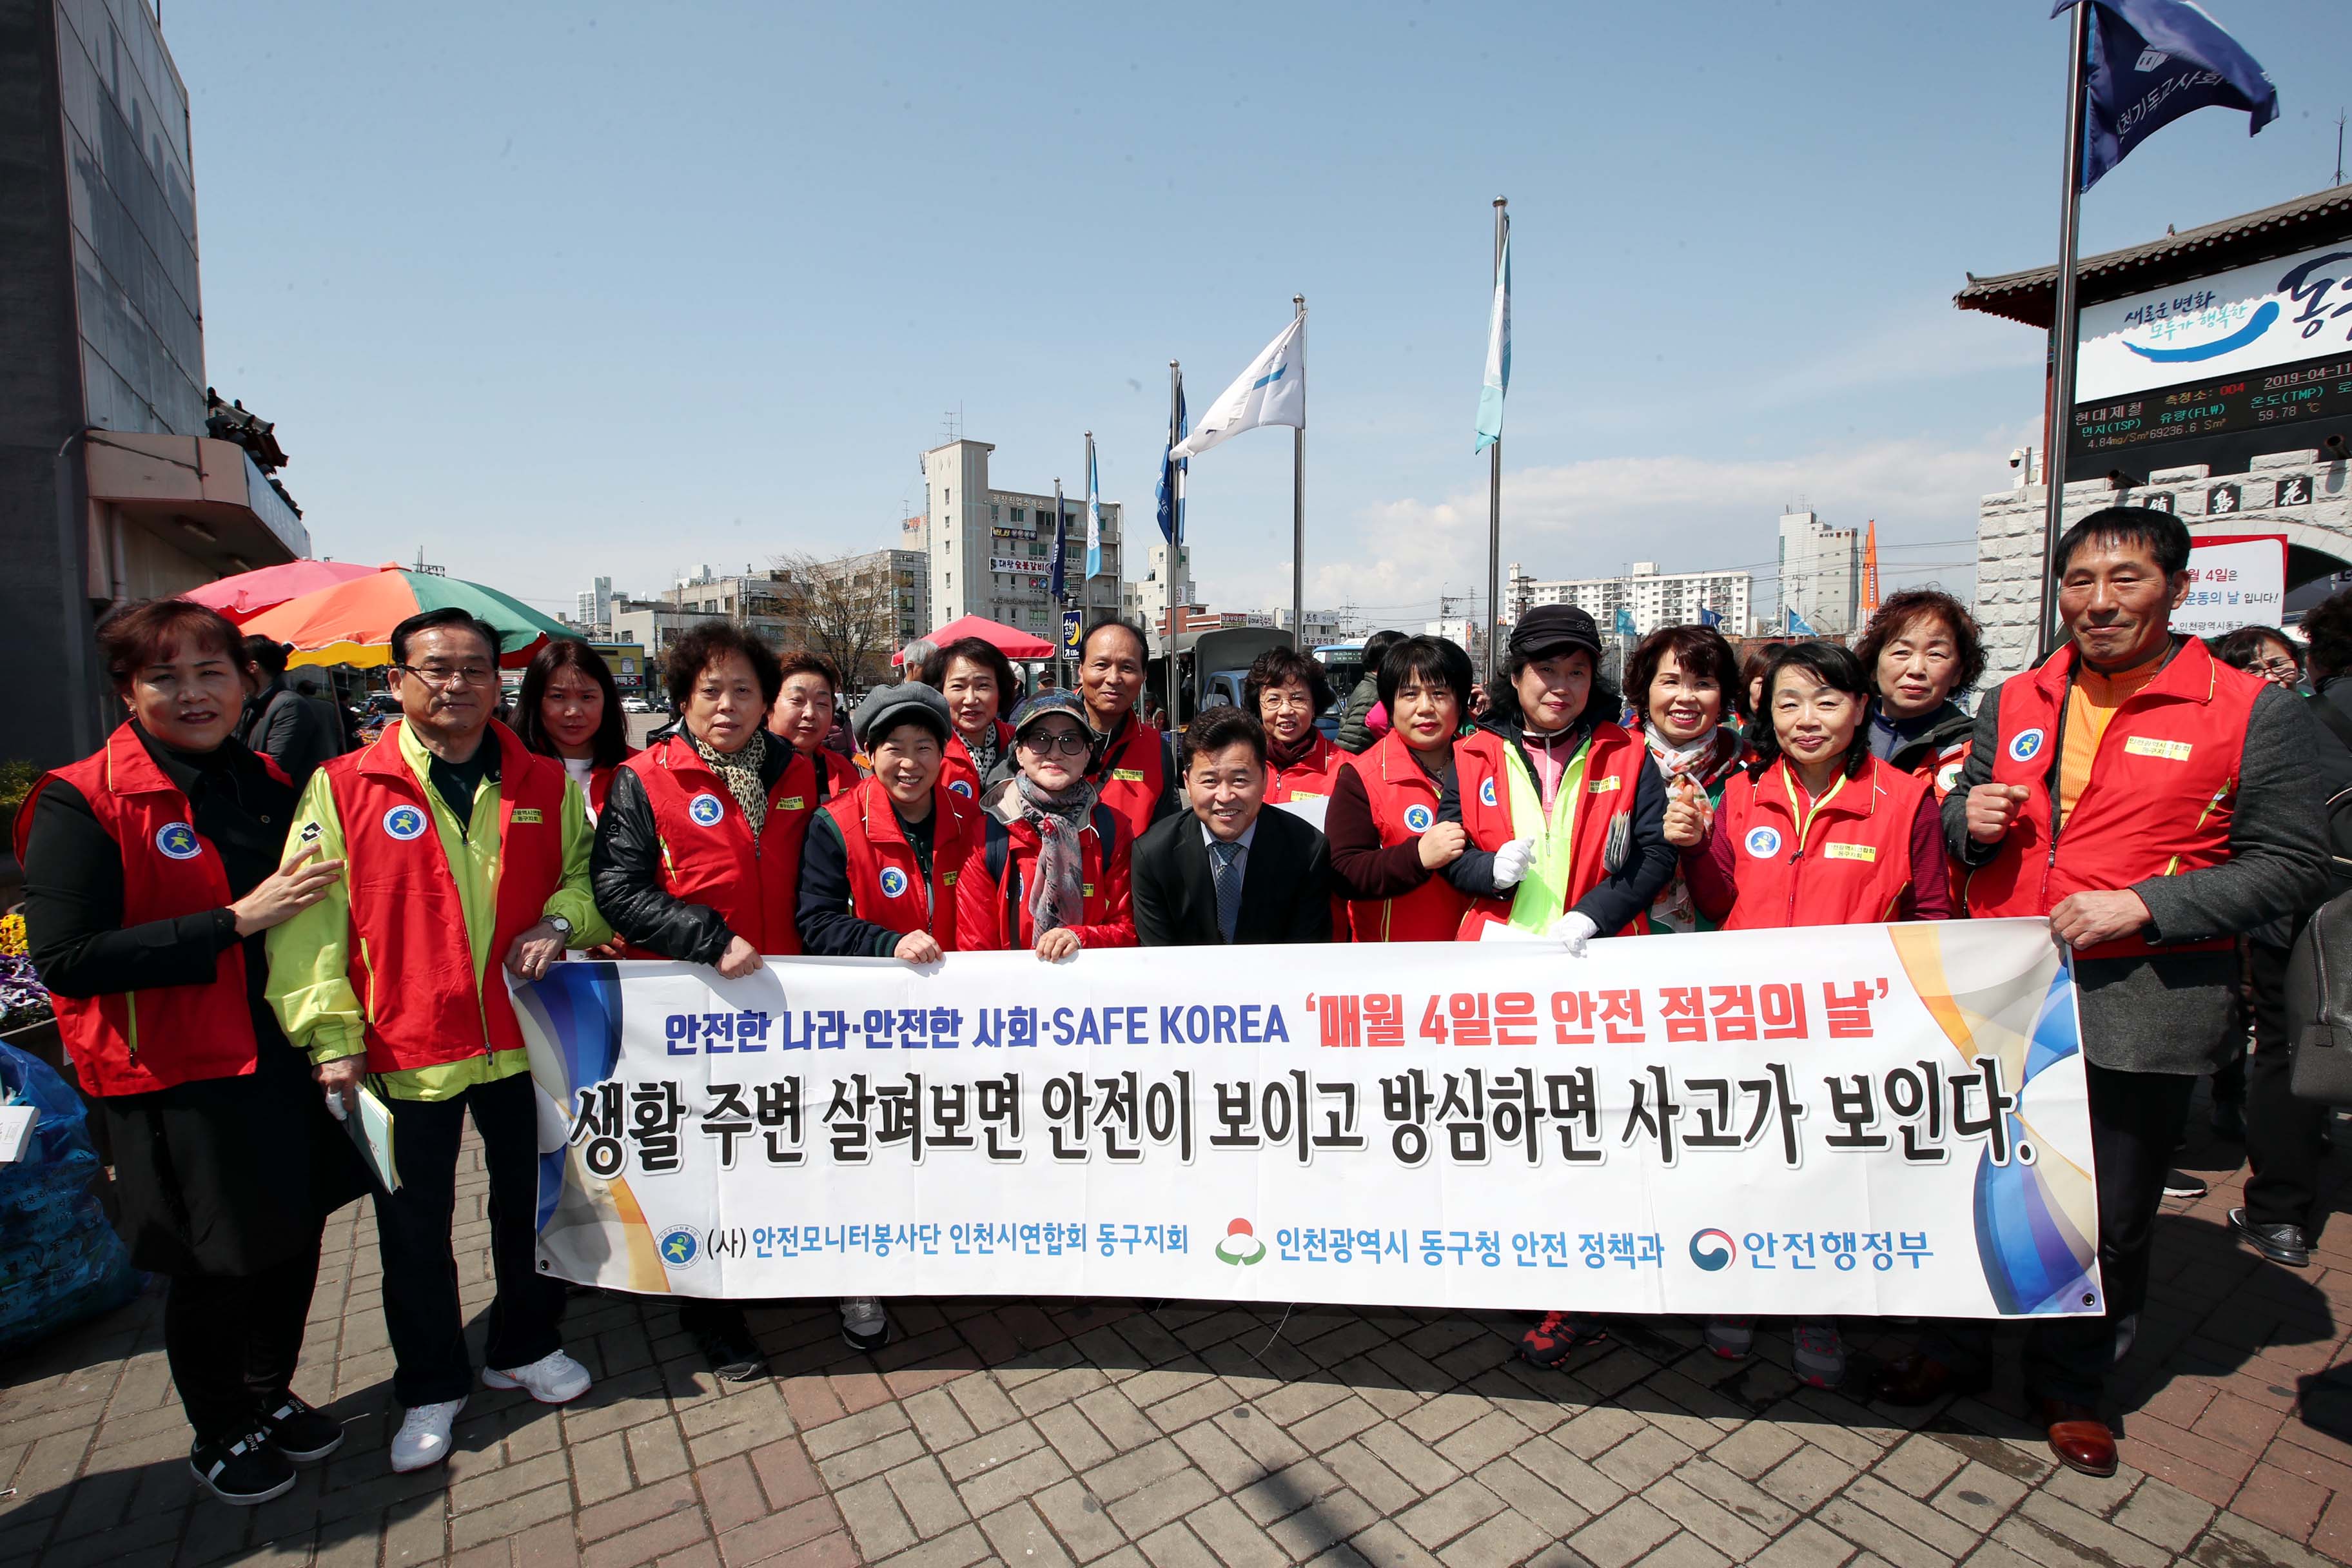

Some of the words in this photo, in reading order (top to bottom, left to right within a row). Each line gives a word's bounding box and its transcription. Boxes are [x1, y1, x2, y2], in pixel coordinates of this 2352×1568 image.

[2124, 304, 2168, 324] 새로운
[2172, 291, 2215, 311] 변화
[2150, 320, 2193, 341] 모두가
[2197, 304, 2249, 329] 행복한
[2219, 382, 2245, 396] 004
[2264, 362, 2352, 387] 2019-04-11
[2075, 403, 2142, 426] 현대제철
[2081, 418, 2142, 438] 먼지(TSP)
[2159, 404, 2226, 424] 유량(FLW)
[2250, 386, 2324, 409] 온도(TMP)
[2258, 406, 2297, 422] 59.78
[993, 494, 1044, 509] 광장직업소개소
[2206, 567, 2238, 582] 4일은
[2228, 591, 2240, 605] 날
[2244, 593, 2279, 604] 입니다!
[666, 1010, 771, 1055] 안전한
[784, 1007, 963, 1050] 나라·안전한
[973, 1006, 1148, 1046] 사회·SAFE
[1161, 1005, 1289, 1043] KOREA
[1420, 993, 1537, 1045] 4일은
[1552, 990, 1645, 1044] 안전
[1661, 984, 1808, 1042] 점검의
[571, 1081, 686, 1175] 생활
[703, 1076, 803, 1166] 주변
[822, 1072, 1023, 1162] 살펴보면
[1042, 1069, 1191, 1162] 안전이
[1210, 1068, 1364, 1162] 보이고
[1378, 1066, 1602, 1164] 방심하면
[1622, 1063, 1803, 1164] 사고가
[1824, 1059, 2031, 1162] 보인다.
[707, 1228, 746, 1259] (사)
[753, 1225, 941, 1258] 안전모니터봉사단
[950, 1223, 1086, 1255] 인천시연합회
[1098, 1224, 1187, 1257] 동구지회
[1277, 1228, 1407, 1263] 인천광역시
[1420, 1231, 1500, 1266] 동구청
[1513, 1233, 1567, 1267] 안전
[1580, 1233, 1664, 1269] 정책과
[1745, 1232, 1932, 1271] 안전행정부
